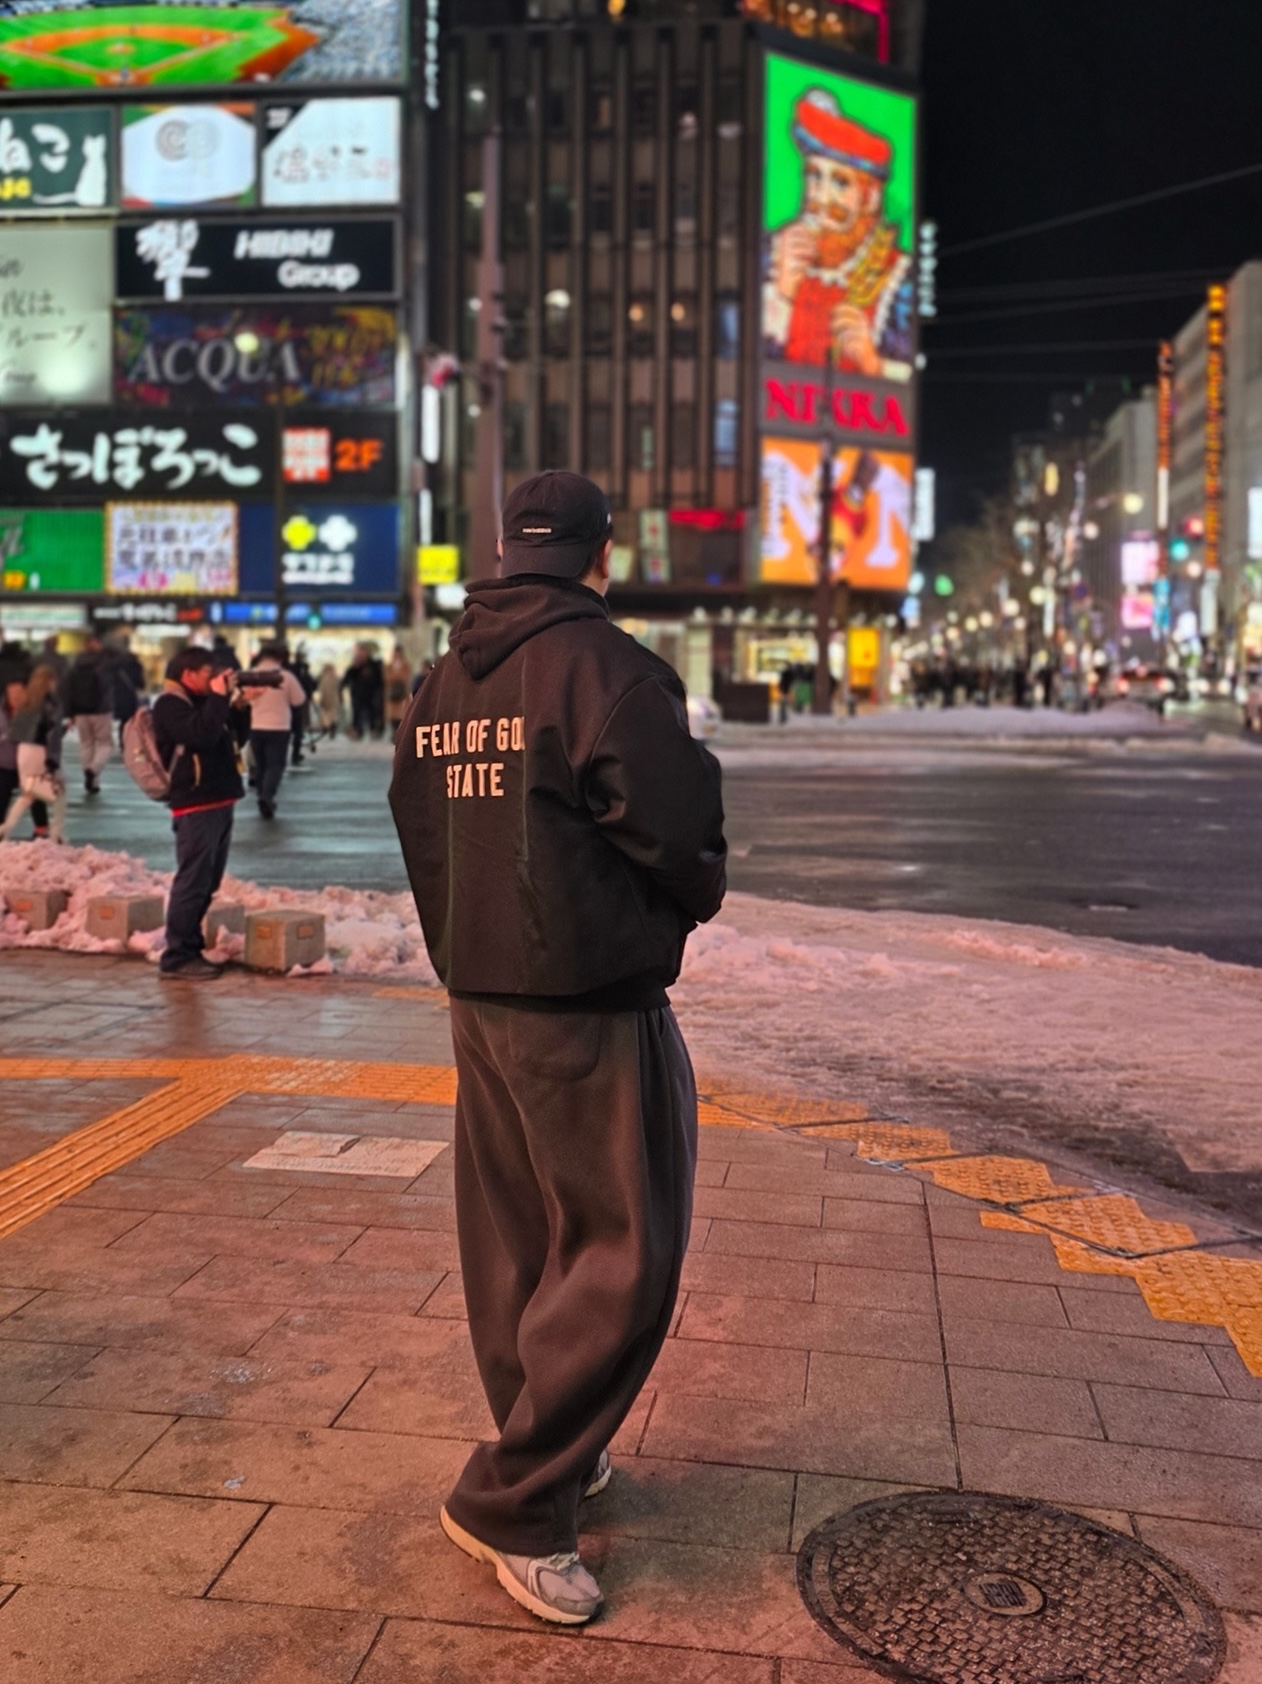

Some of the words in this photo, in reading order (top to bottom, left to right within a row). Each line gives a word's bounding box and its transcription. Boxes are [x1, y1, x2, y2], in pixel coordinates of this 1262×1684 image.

[278, 260, 360, 291] Group
[129, 338, 300, 392] ACQUA
[335, 439, 382, 470] 2F
[415, 721, 461, 758] FEAR
[465, 718, 492, 753] OF
[495, 716, 526, 752] GO
[446, 762, 505, 799] STATE
